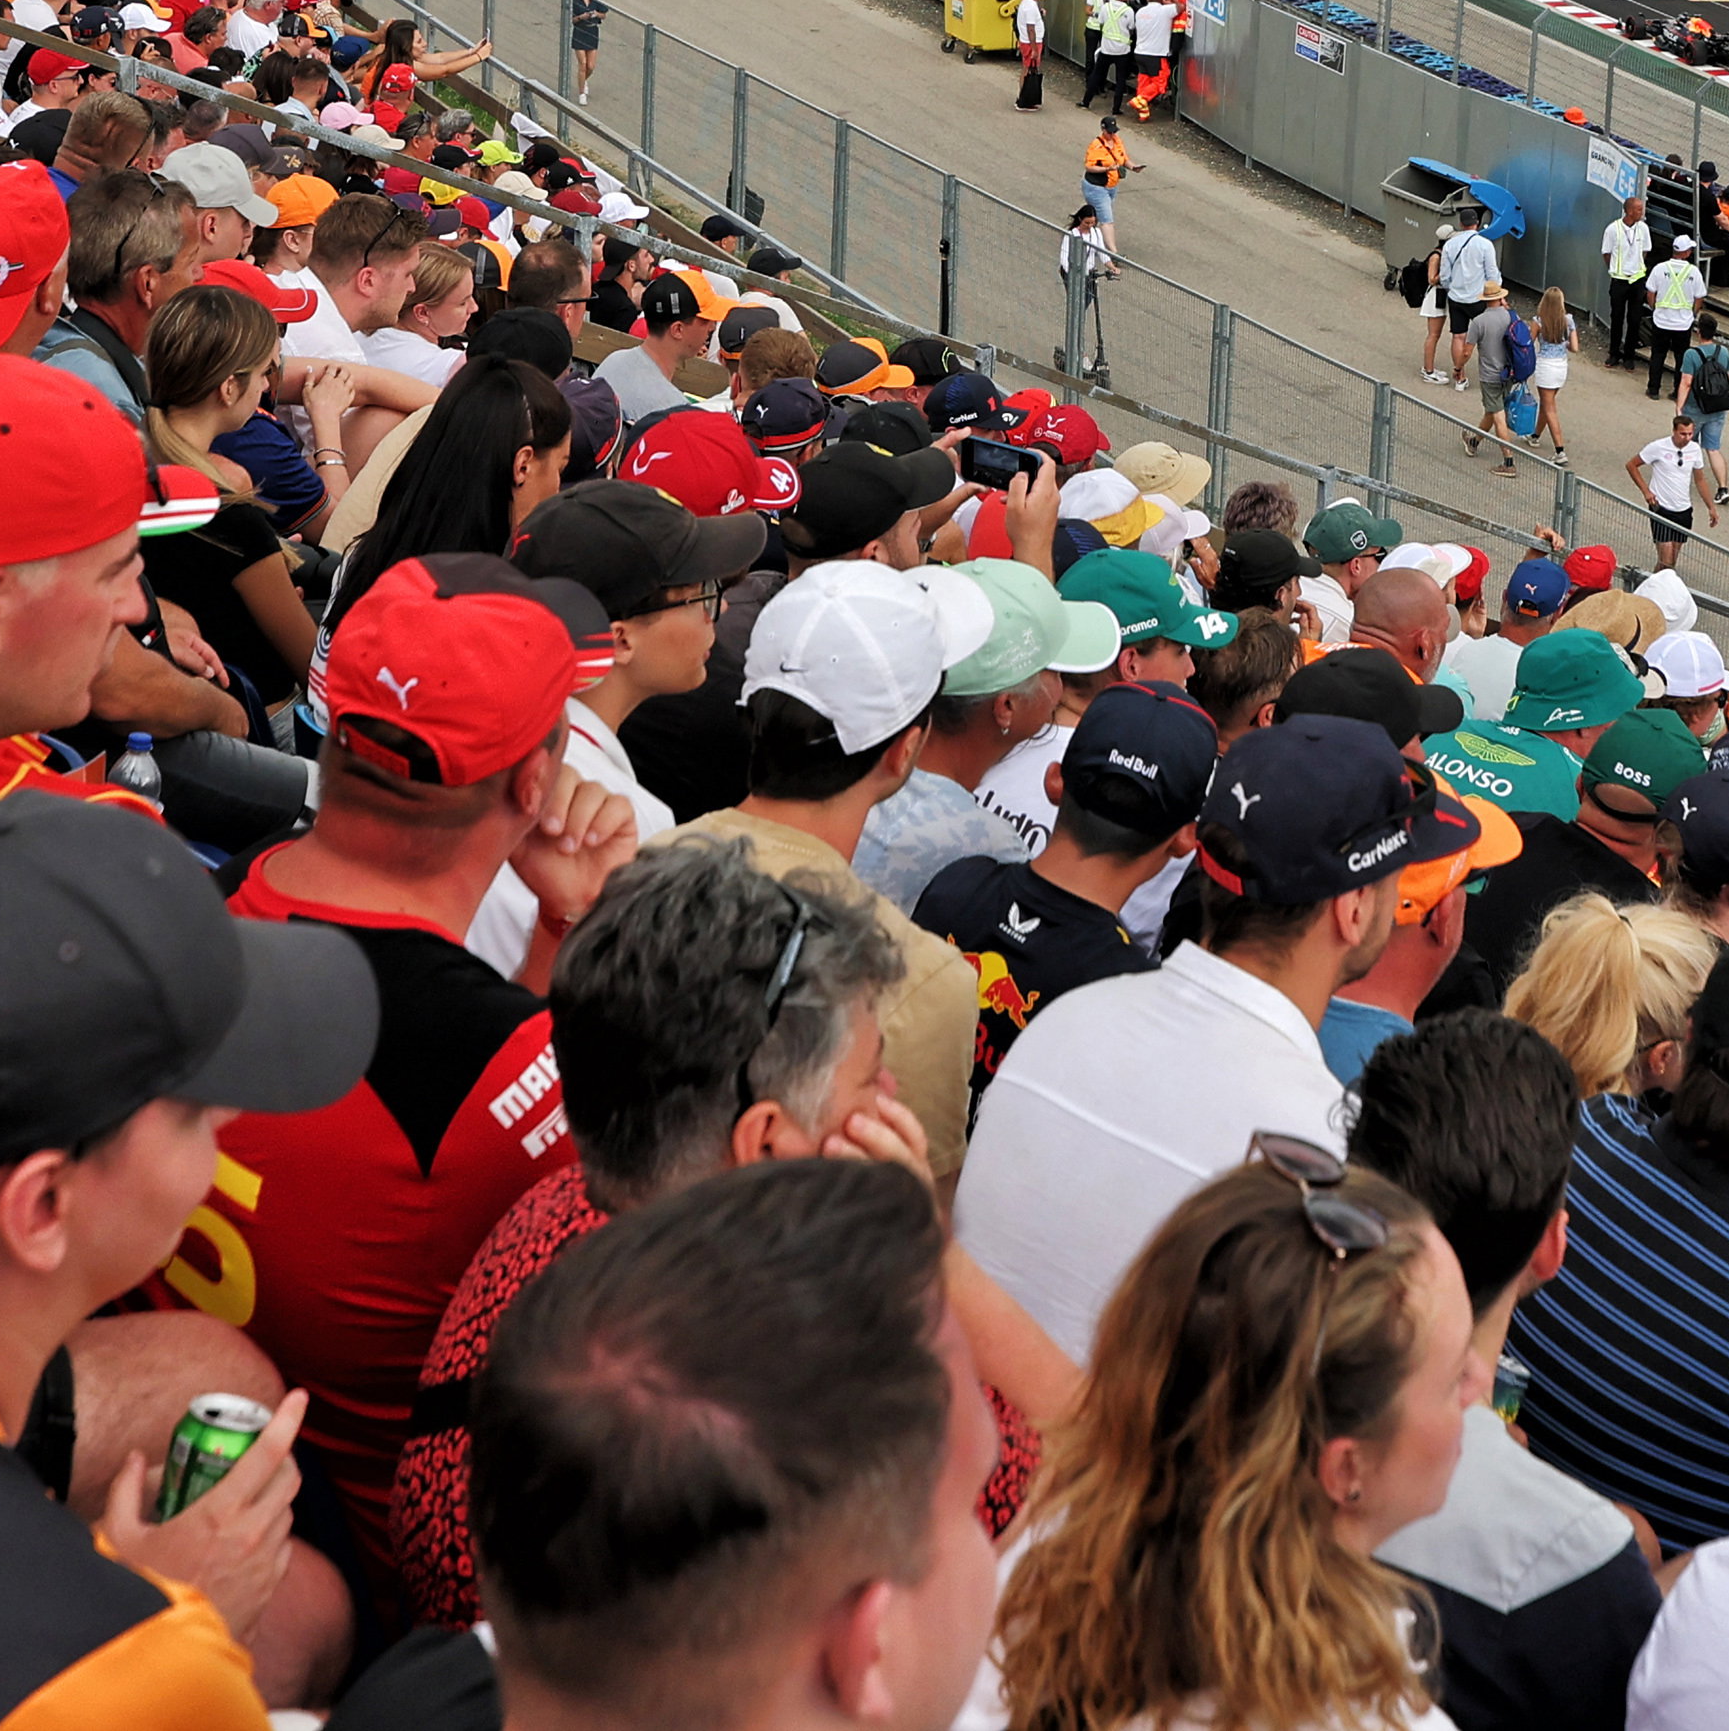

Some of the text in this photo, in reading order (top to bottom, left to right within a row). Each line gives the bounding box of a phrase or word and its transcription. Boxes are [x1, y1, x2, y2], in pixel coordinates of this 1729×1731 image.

[949, 411, 978, 424] CarNext
[770, 467, 792, 494] 44
[1119, 616, 1159, 637] aramco
[1194, 604, 1229, 640] 14
[1425, 751, 1513, 798] ALONSO
[1614, 762, 1652, 787] BOSS
[1348, 829, 1408, 872] CarNext
